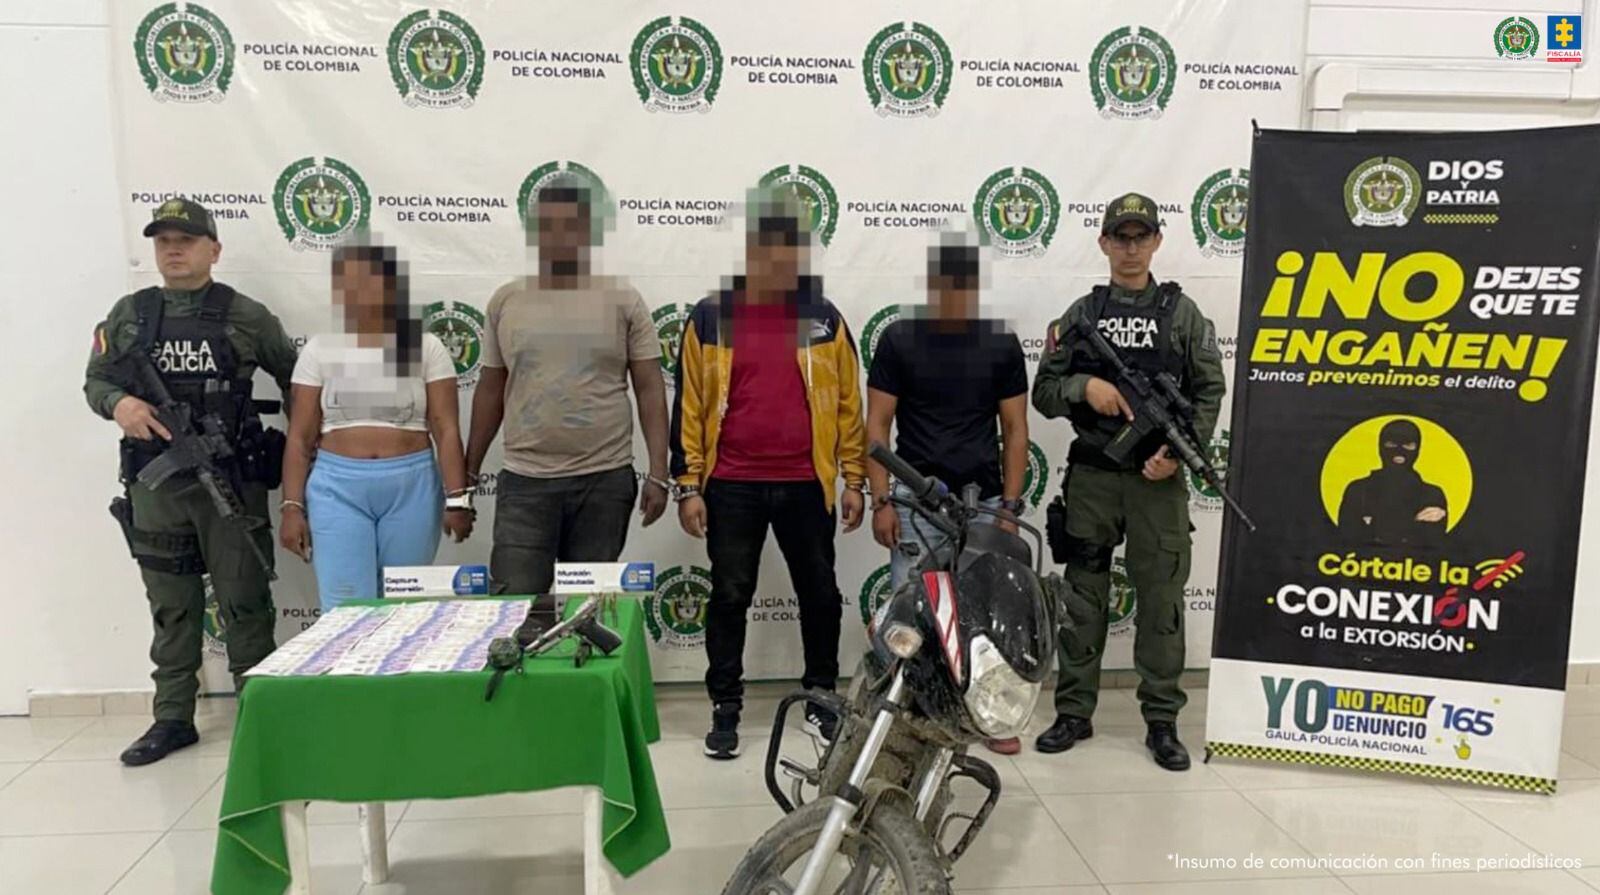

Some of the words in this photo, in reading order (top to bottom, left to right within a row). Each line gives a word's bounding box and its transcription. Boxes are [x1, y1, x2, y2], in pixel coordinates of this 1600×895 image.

[243, 42, 299, 56] POLICÍA
[302, 45, 379, 58] NACIONAL
[493, 48, 548, 62] POLICÍA
[551, 51, 623, 64] NACIONAL
[263, 60, 281, 72] DE
[285, 60, 361, 72] COLOMBIA
[731, 55, 783, 68] POLICÍA
[786, 58, 856, 70] NACIONAL
[960, 59, 1010, 72] POLICÍA
[1013, 61, 1081, 73] NACIONAL
[1184, 62, 1231, 75] POLICÍA
[1234, 64, 1299, 76] NACIONAL
[512, 66, 529, 77] DE
[534, 66, 606, 78] COLOMBIA
[748, 72, 765, 83] DE
[769, 72, 838, 84] COLOMBIA
[976, 76, 992, 87] DE
[996, 76, 1063, 88] COLOMBIA
[1200, 79, 1214, 90] DE
[1217, 80, 1282, 91] COLOMBIA
[1428, 160, 1504, 181] DIOS
[1460, 180, 1470, 190] Y
[192, 194, 266, 204] NACIONAL
[378, 194, 432, 207] POLICÍA
[436, 197, 508, 208] NACIONAL
[619, 197, 672, 210] POLICÍA
[1426, 190, 1500, 205] PATRIA
[847, 200, 897, 212] POLICÍA
[901, 203, 967, 213] NACIONAL
[397, 211, 415, 222] DE
[418, 211, 491, 222] COLOMBIA
[637, 215, 654, 225] DE
[864, 217, 880, 227] DE
[1084, 218, 1100, 227] DE
[1473, 266, 1582, 290] DEJES
[1260, 251, 1465, 322] ¡NO
[1469, 294, 1539, 319] QUE
[1541, 295, 1580, 315] TE
[1097, 317, 1158, 334] POLICIA
[157, 356, 217, 372] OLICIA
[1248, 368, 1305, 383] Juntos
[1308, 369, 1440, 387] prevenimos
[1444, 374, 1460, 388] el
[1465, 374, 1516, 390] delito
[1318, 552, 1432, 582] Córtale
[1439, 561, 1470, 585] la
[1276, 584, 1499, 631] CONEXIÓN
[753, 612, 768, 621] DE
[1300, 626, 1313, 638] a
[1319, 622, 1337, 639] la
[1344, 627, 1464, 652] EXTORSIÓN
[1261, 676, 1329, 733] YO
[1335, 689, 1365, 710] NO
[1371, 692, 1426, 716] PAGO
[1333, 714, 1427, 739] DENUNCIO
[1441, 703, 1494, 737] 165
[1265, 730, 1307, 742] GAULA
[1310, 733, 1359, 748] POLICÍA
[1362, 740, 1427, 755] NACIONAL
